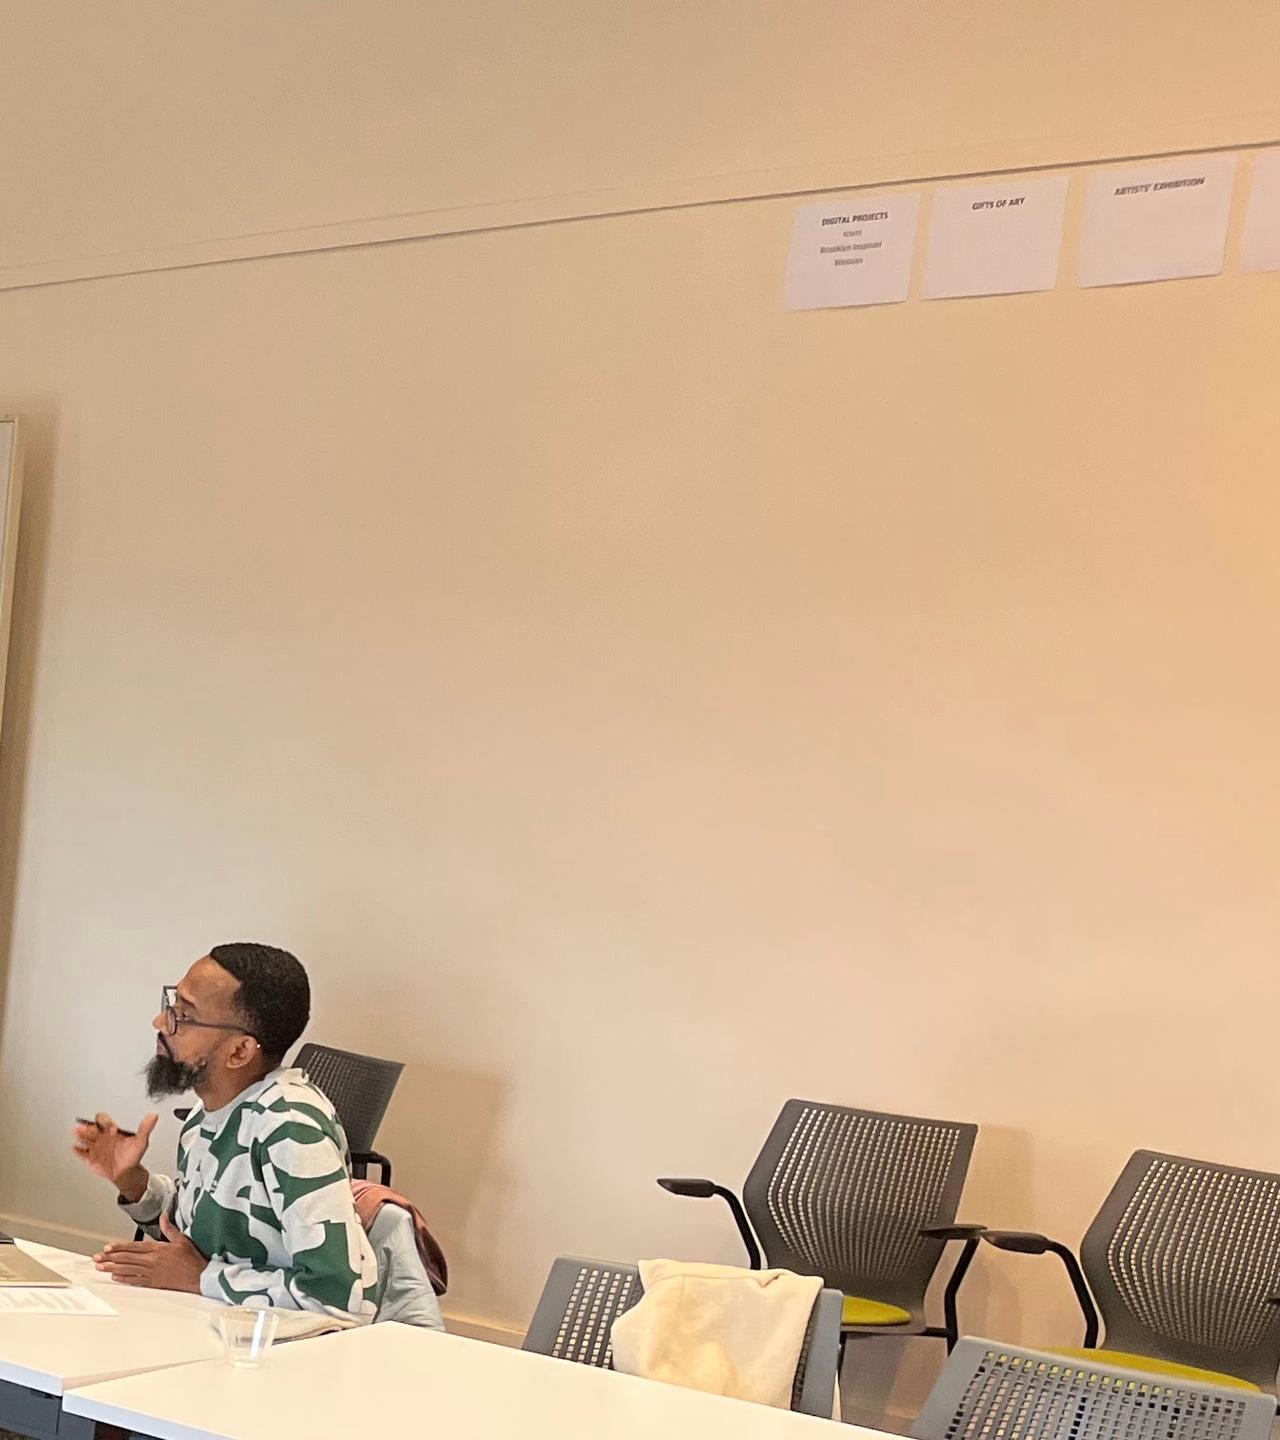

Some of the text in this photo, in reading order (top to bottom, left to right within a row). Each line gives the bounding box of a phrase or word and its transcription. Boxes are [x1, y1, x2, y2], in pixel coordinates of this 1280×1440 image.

[972, 197, 1025, 210] GIFTS OF ART
[822, 212, 888, 226] DIGITAL PROJECTS
